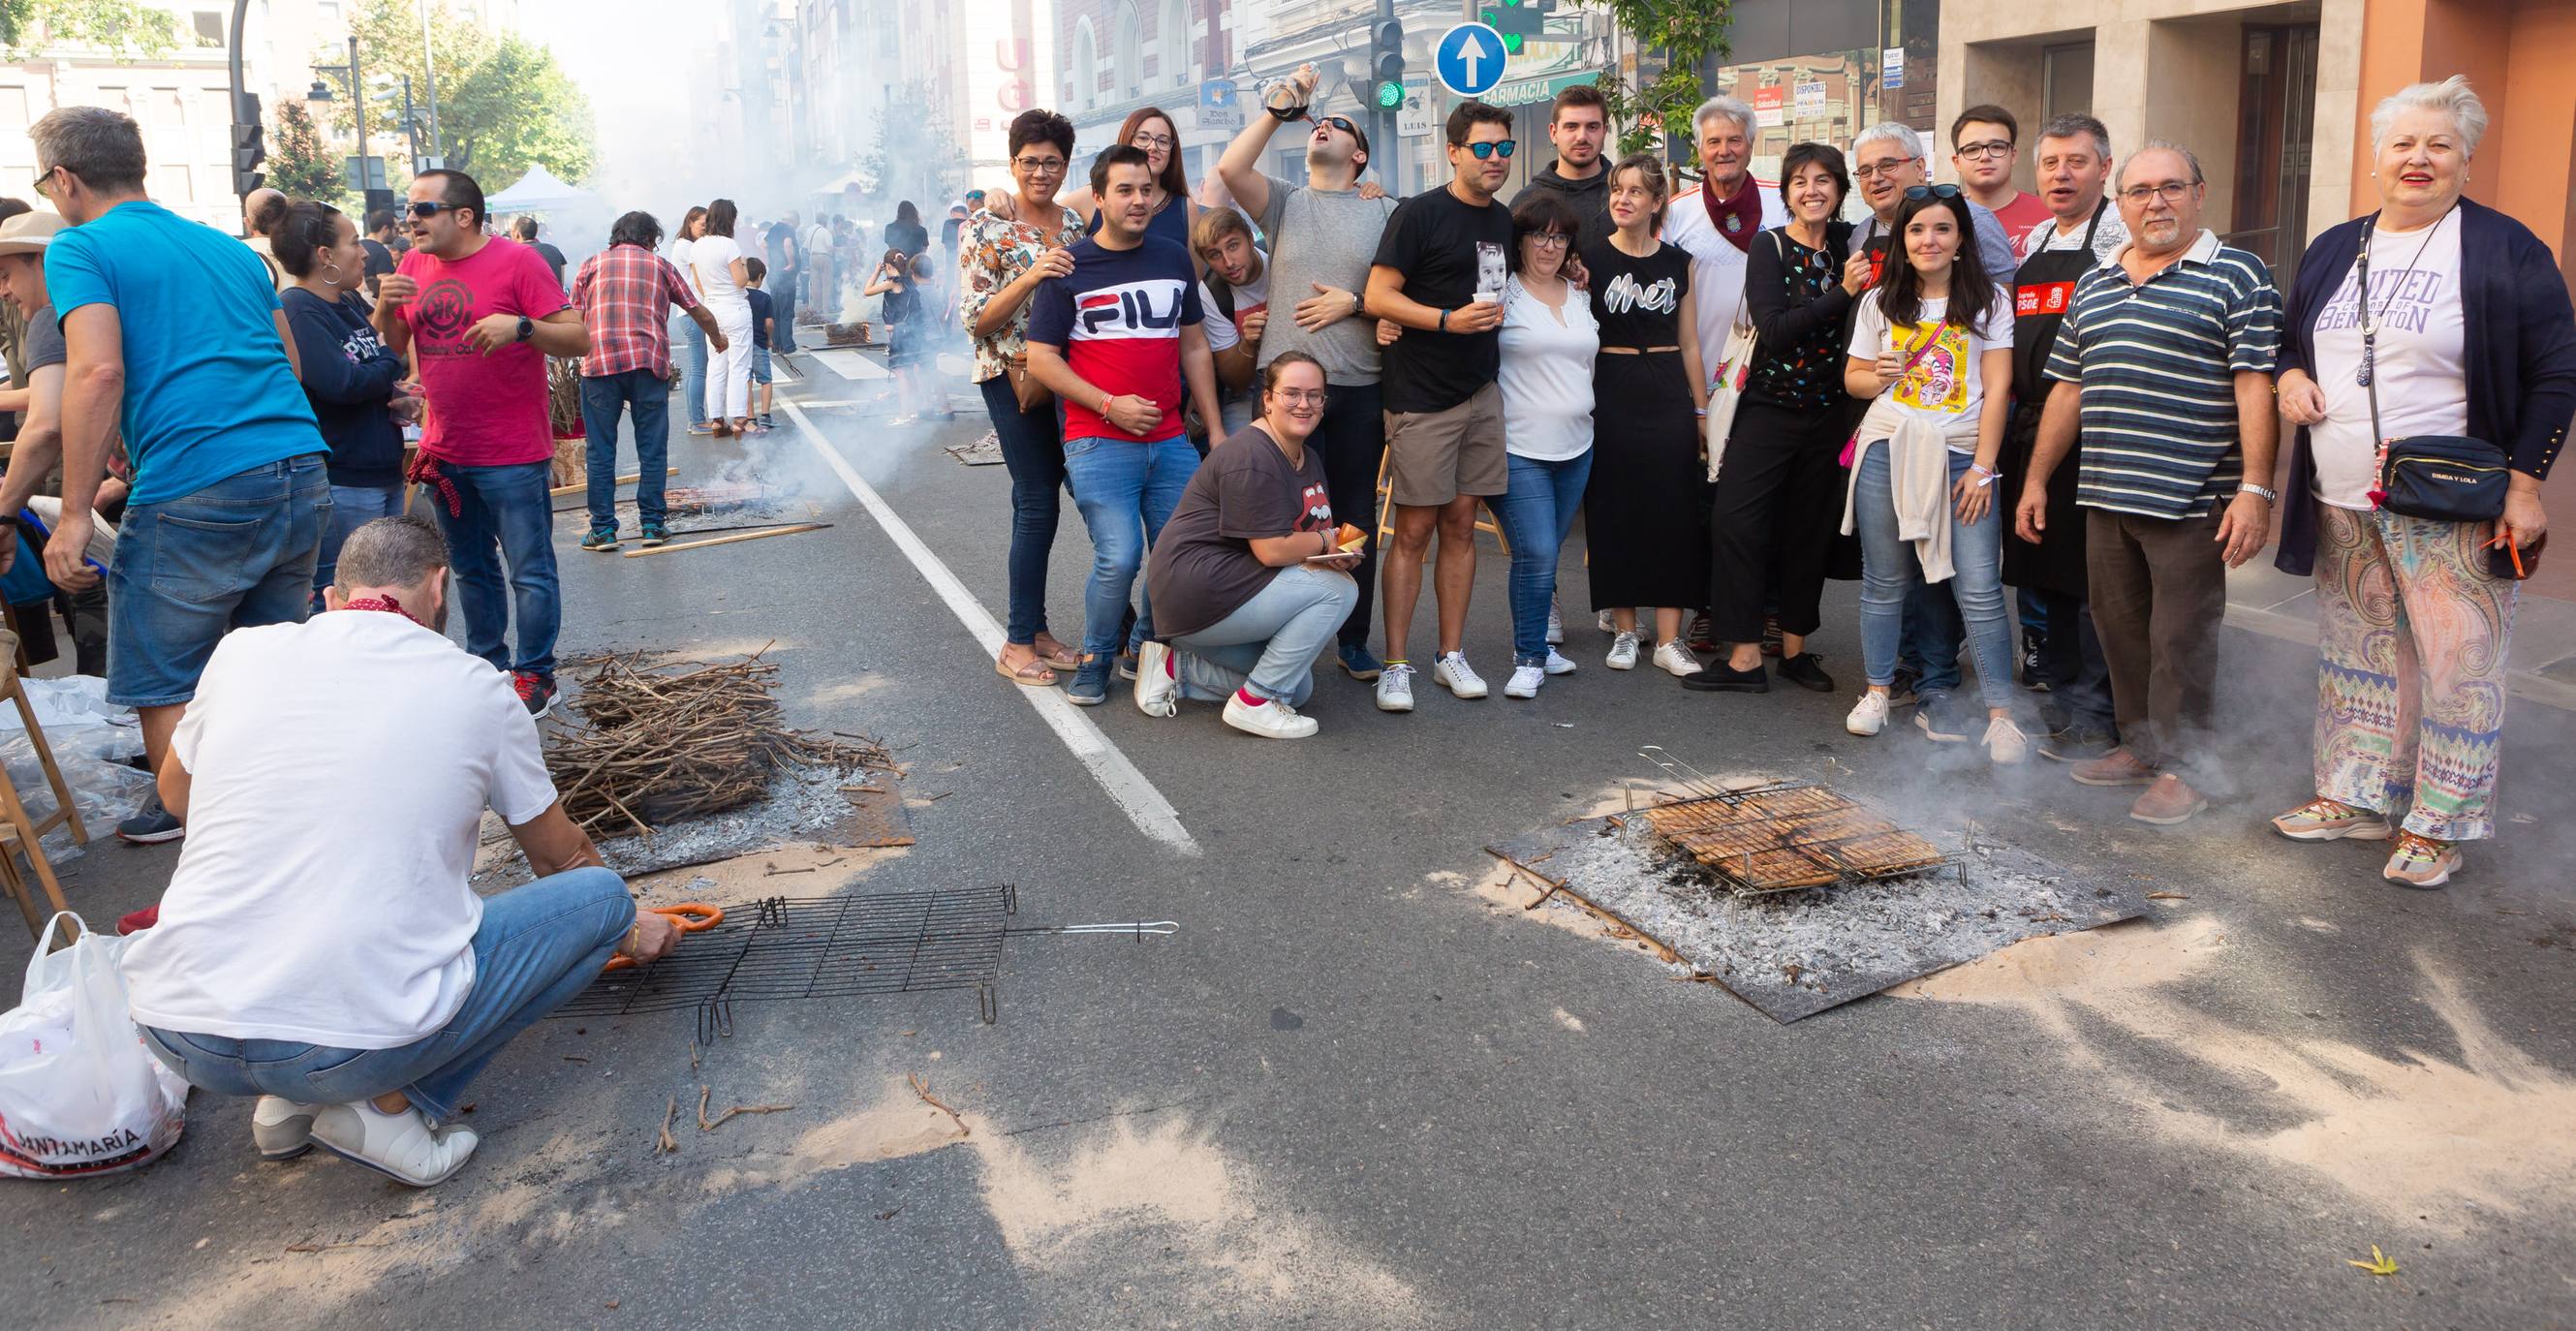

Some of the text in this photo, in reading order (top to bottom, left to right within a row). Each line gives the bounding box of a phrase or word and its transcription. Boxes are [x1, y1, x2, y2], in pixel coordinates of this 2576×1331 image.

[1483, 79, 1550, 104] FARMACIA
[1796, 83, 1825, 95] DISPONIBLE
[1404, 120, 1427, 131] LUIS
[2017, 298, 2039, 311] PSOE
